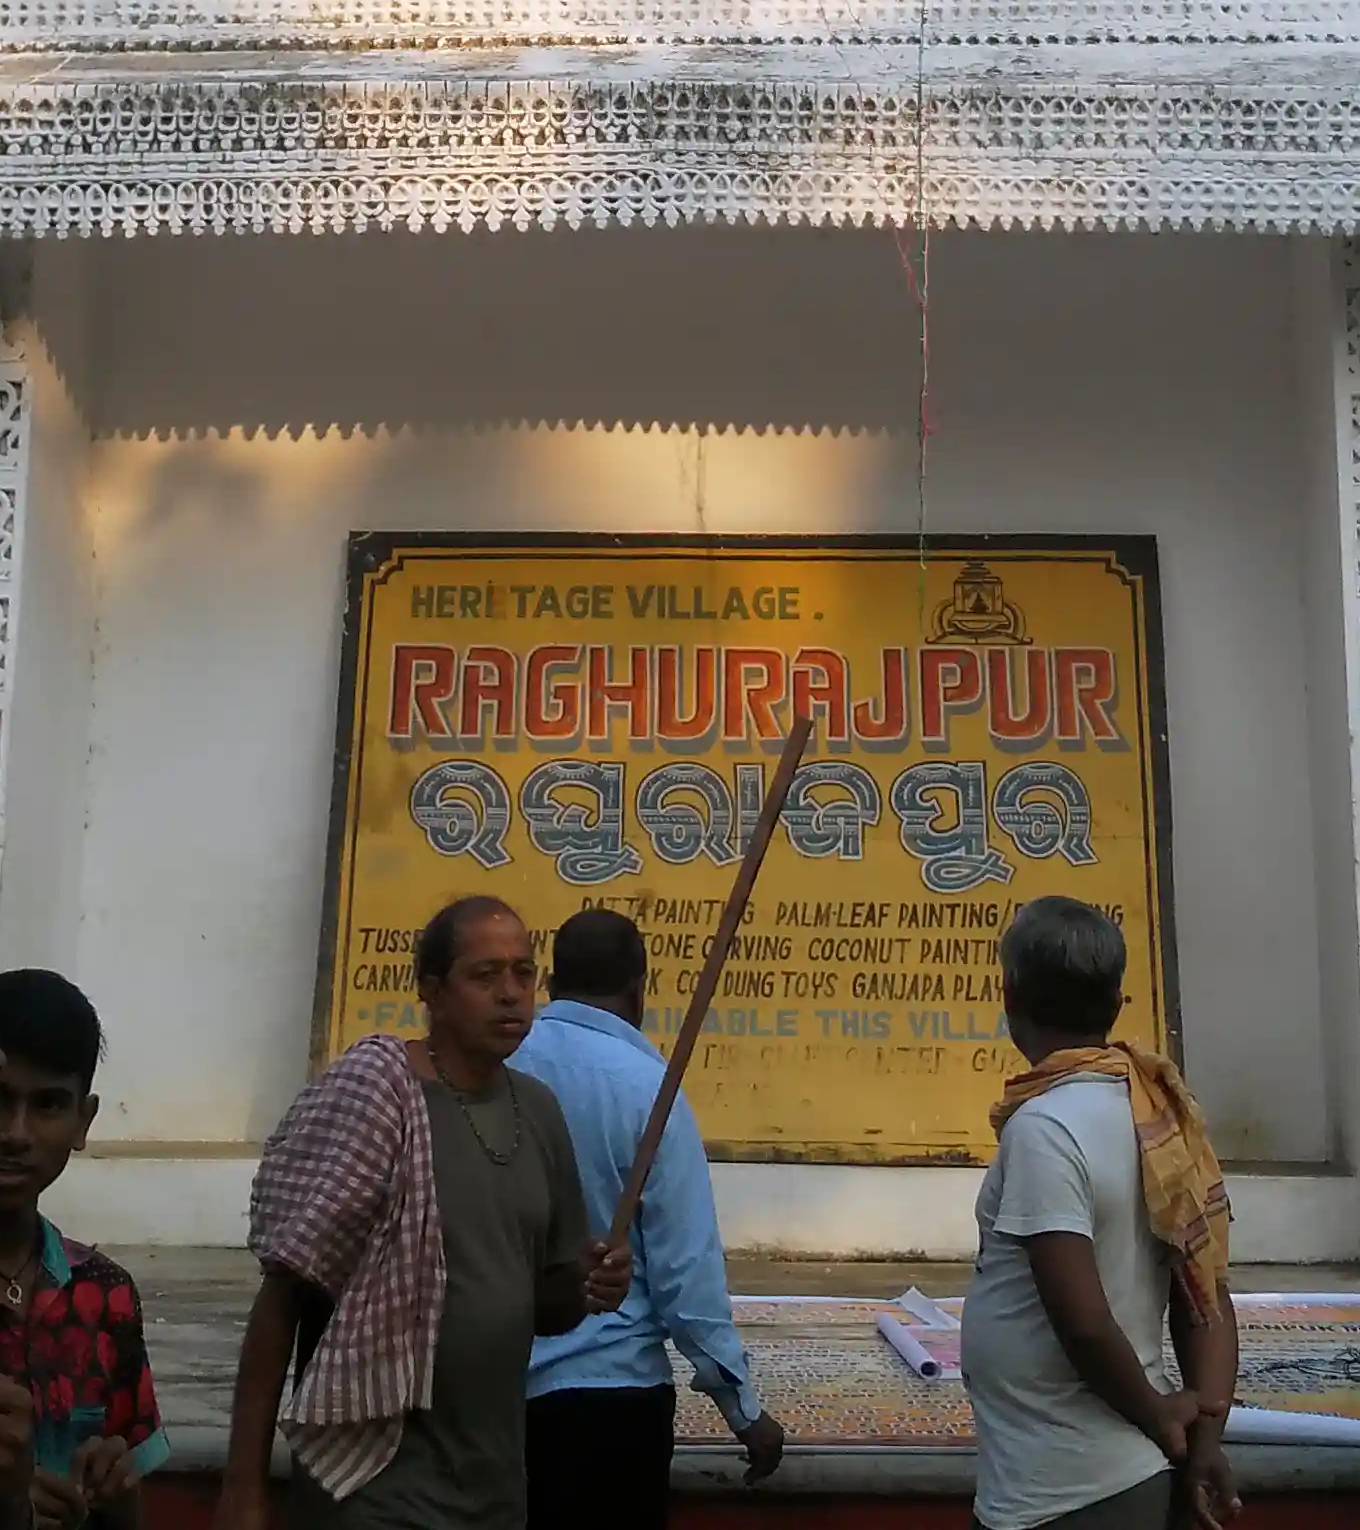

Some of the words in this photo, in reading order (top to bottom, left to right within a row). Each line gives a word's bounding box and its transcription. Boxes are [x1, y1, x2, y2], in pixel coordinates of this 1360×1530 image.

[386, 641, 1126, 750] RAGHURAJPUR
[653, 898, 755, 925] PAINTIG
[701, 935, 792, 962] CRVING
[808, 937, 912, 964] COCONUT
[723, 970, 775, 998] DUNG
[781, 971, 839, 1000] TOYS
[851, 972, 945, 1002] GANJAPA
[815, 1010, 894, 1039] THIS
